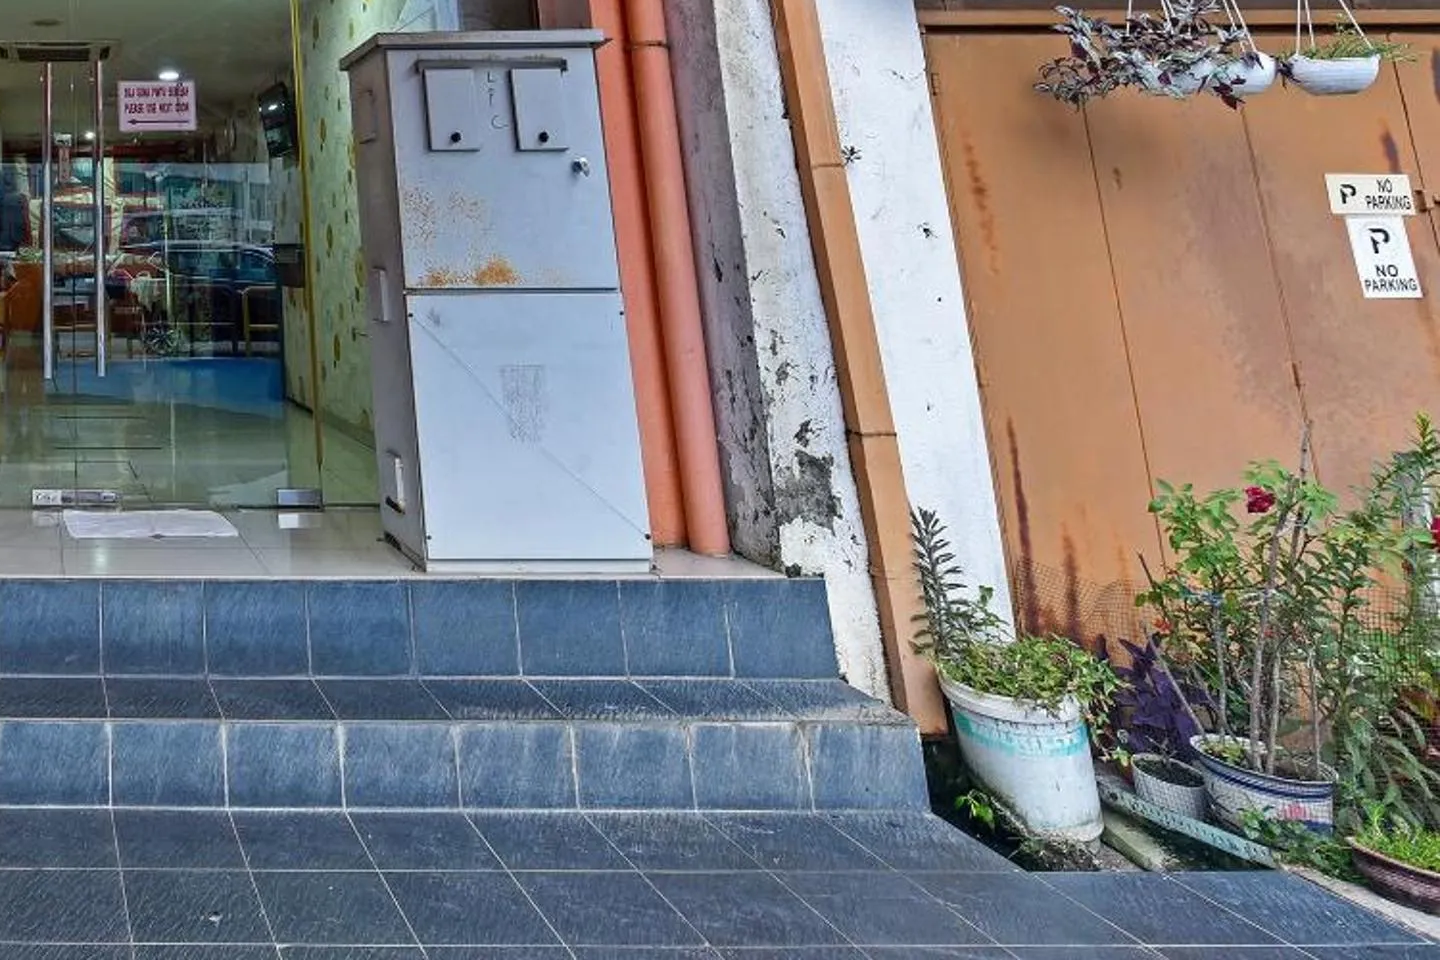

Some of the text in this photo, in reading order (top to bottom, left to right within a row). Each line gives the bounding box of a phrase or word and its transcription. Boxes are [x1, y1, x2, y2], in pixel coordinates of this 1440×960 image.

[1376, 178, 1393, 193] NO
[1365, 195, 1411, 210] PARKING
[1375, 264, 1399, 277] NO
[1365, 279, 1418, 291] PARKING
